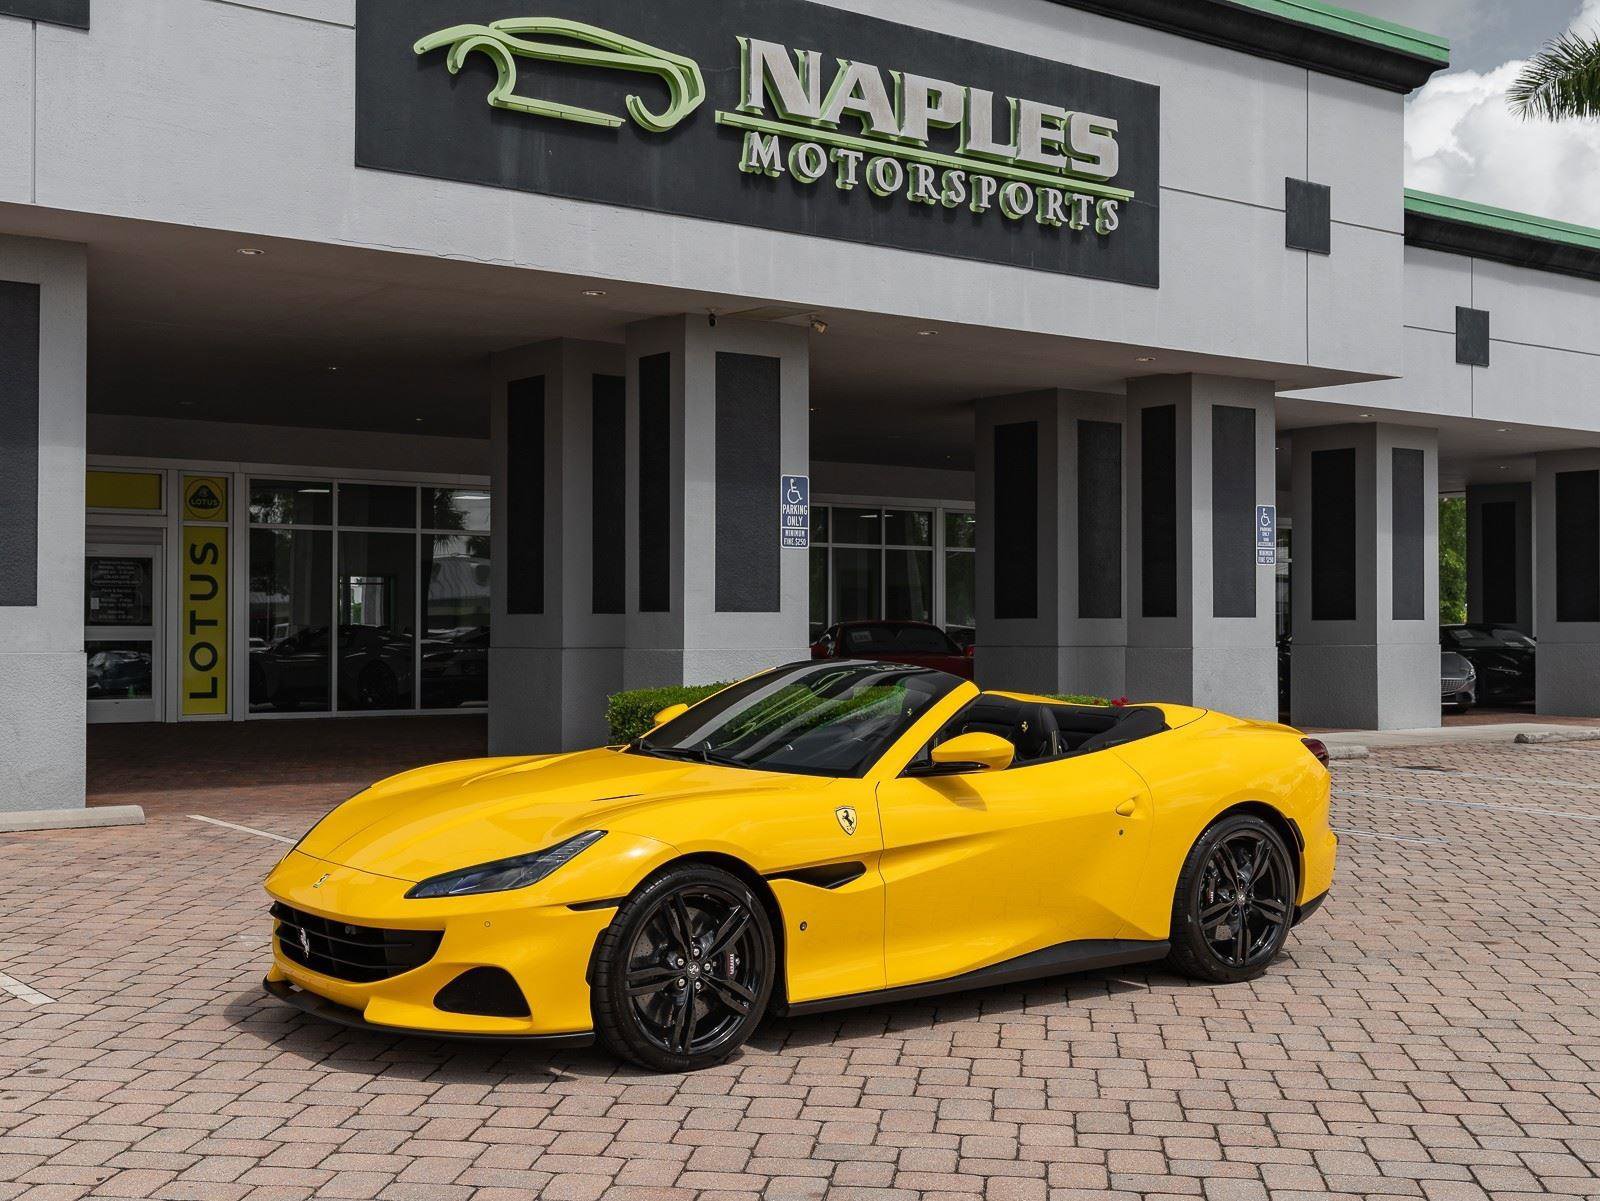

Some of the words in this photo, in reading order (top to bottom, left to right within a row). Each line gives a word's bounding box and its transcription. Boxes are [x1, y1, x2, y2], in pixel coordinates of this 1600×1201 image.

[736, 36, 1119, 181] NAPLES
[739, 131, 1120, 235] MOTORSPORTS
[191, 498, 218, 506] LOTUS
[783, 504, 808, 515] PARKING
[787, 516, 803, 526] ONLY
[795, 538, 807, 546] $250
[189, 542, 219, 699] LOTUS
